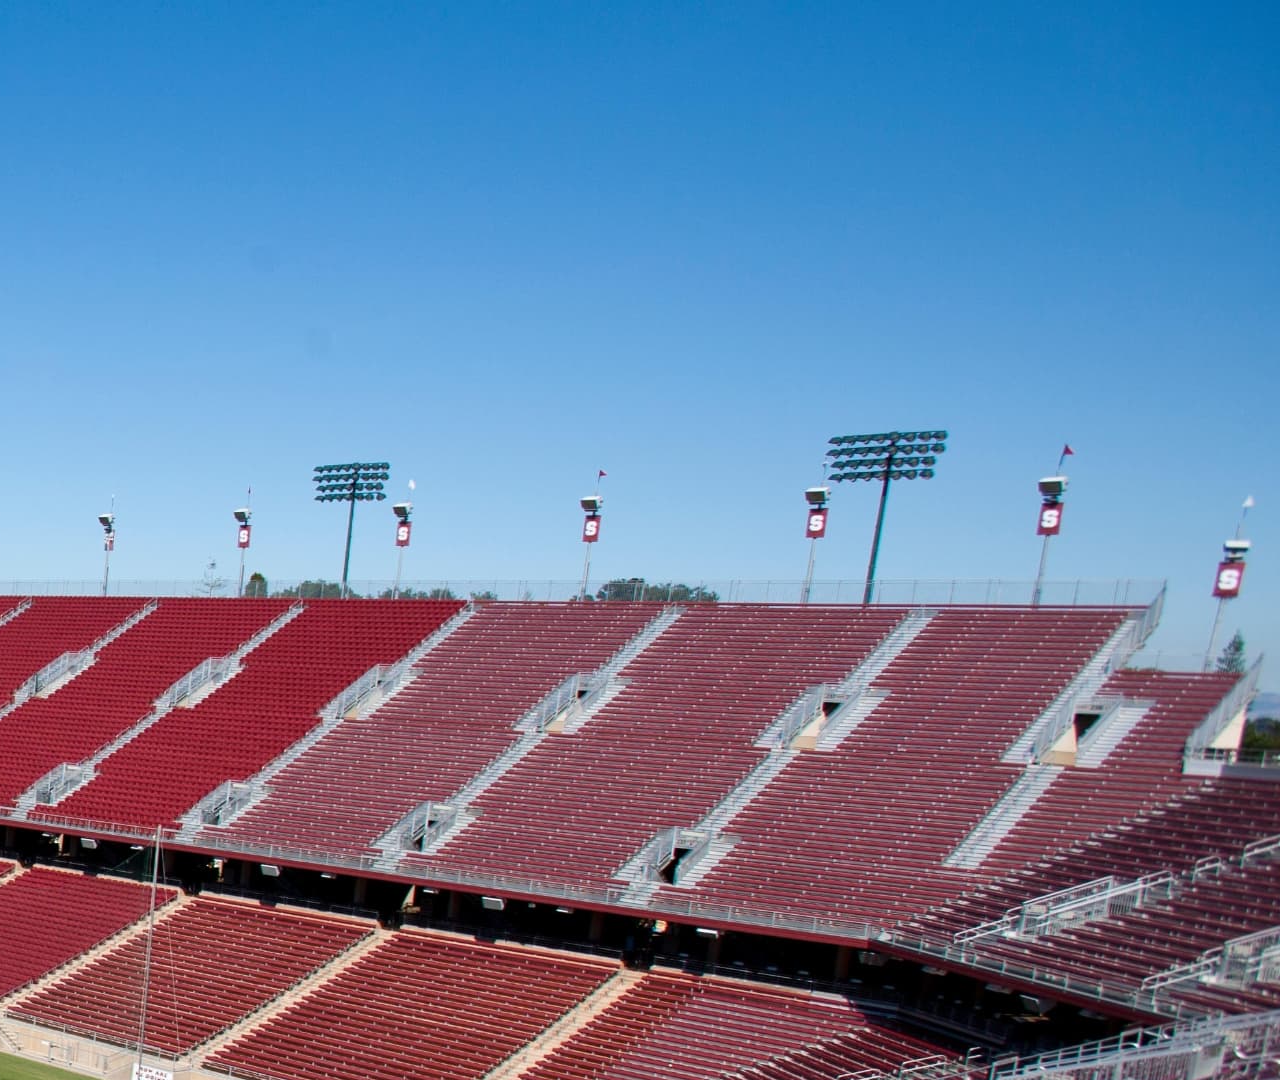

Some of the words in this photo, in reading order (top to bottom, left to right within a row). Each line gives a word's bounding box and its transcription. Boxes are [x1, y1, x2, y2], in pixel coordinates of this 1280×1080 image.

[809, 515, 824, 531] S
[1041, 509, 1060, 528] S
[398, 526, 408, 540] S
[585, 521, 597, 536] S
[239, 530, 248, 543] S
[1218, 569, 1240, 590] S
